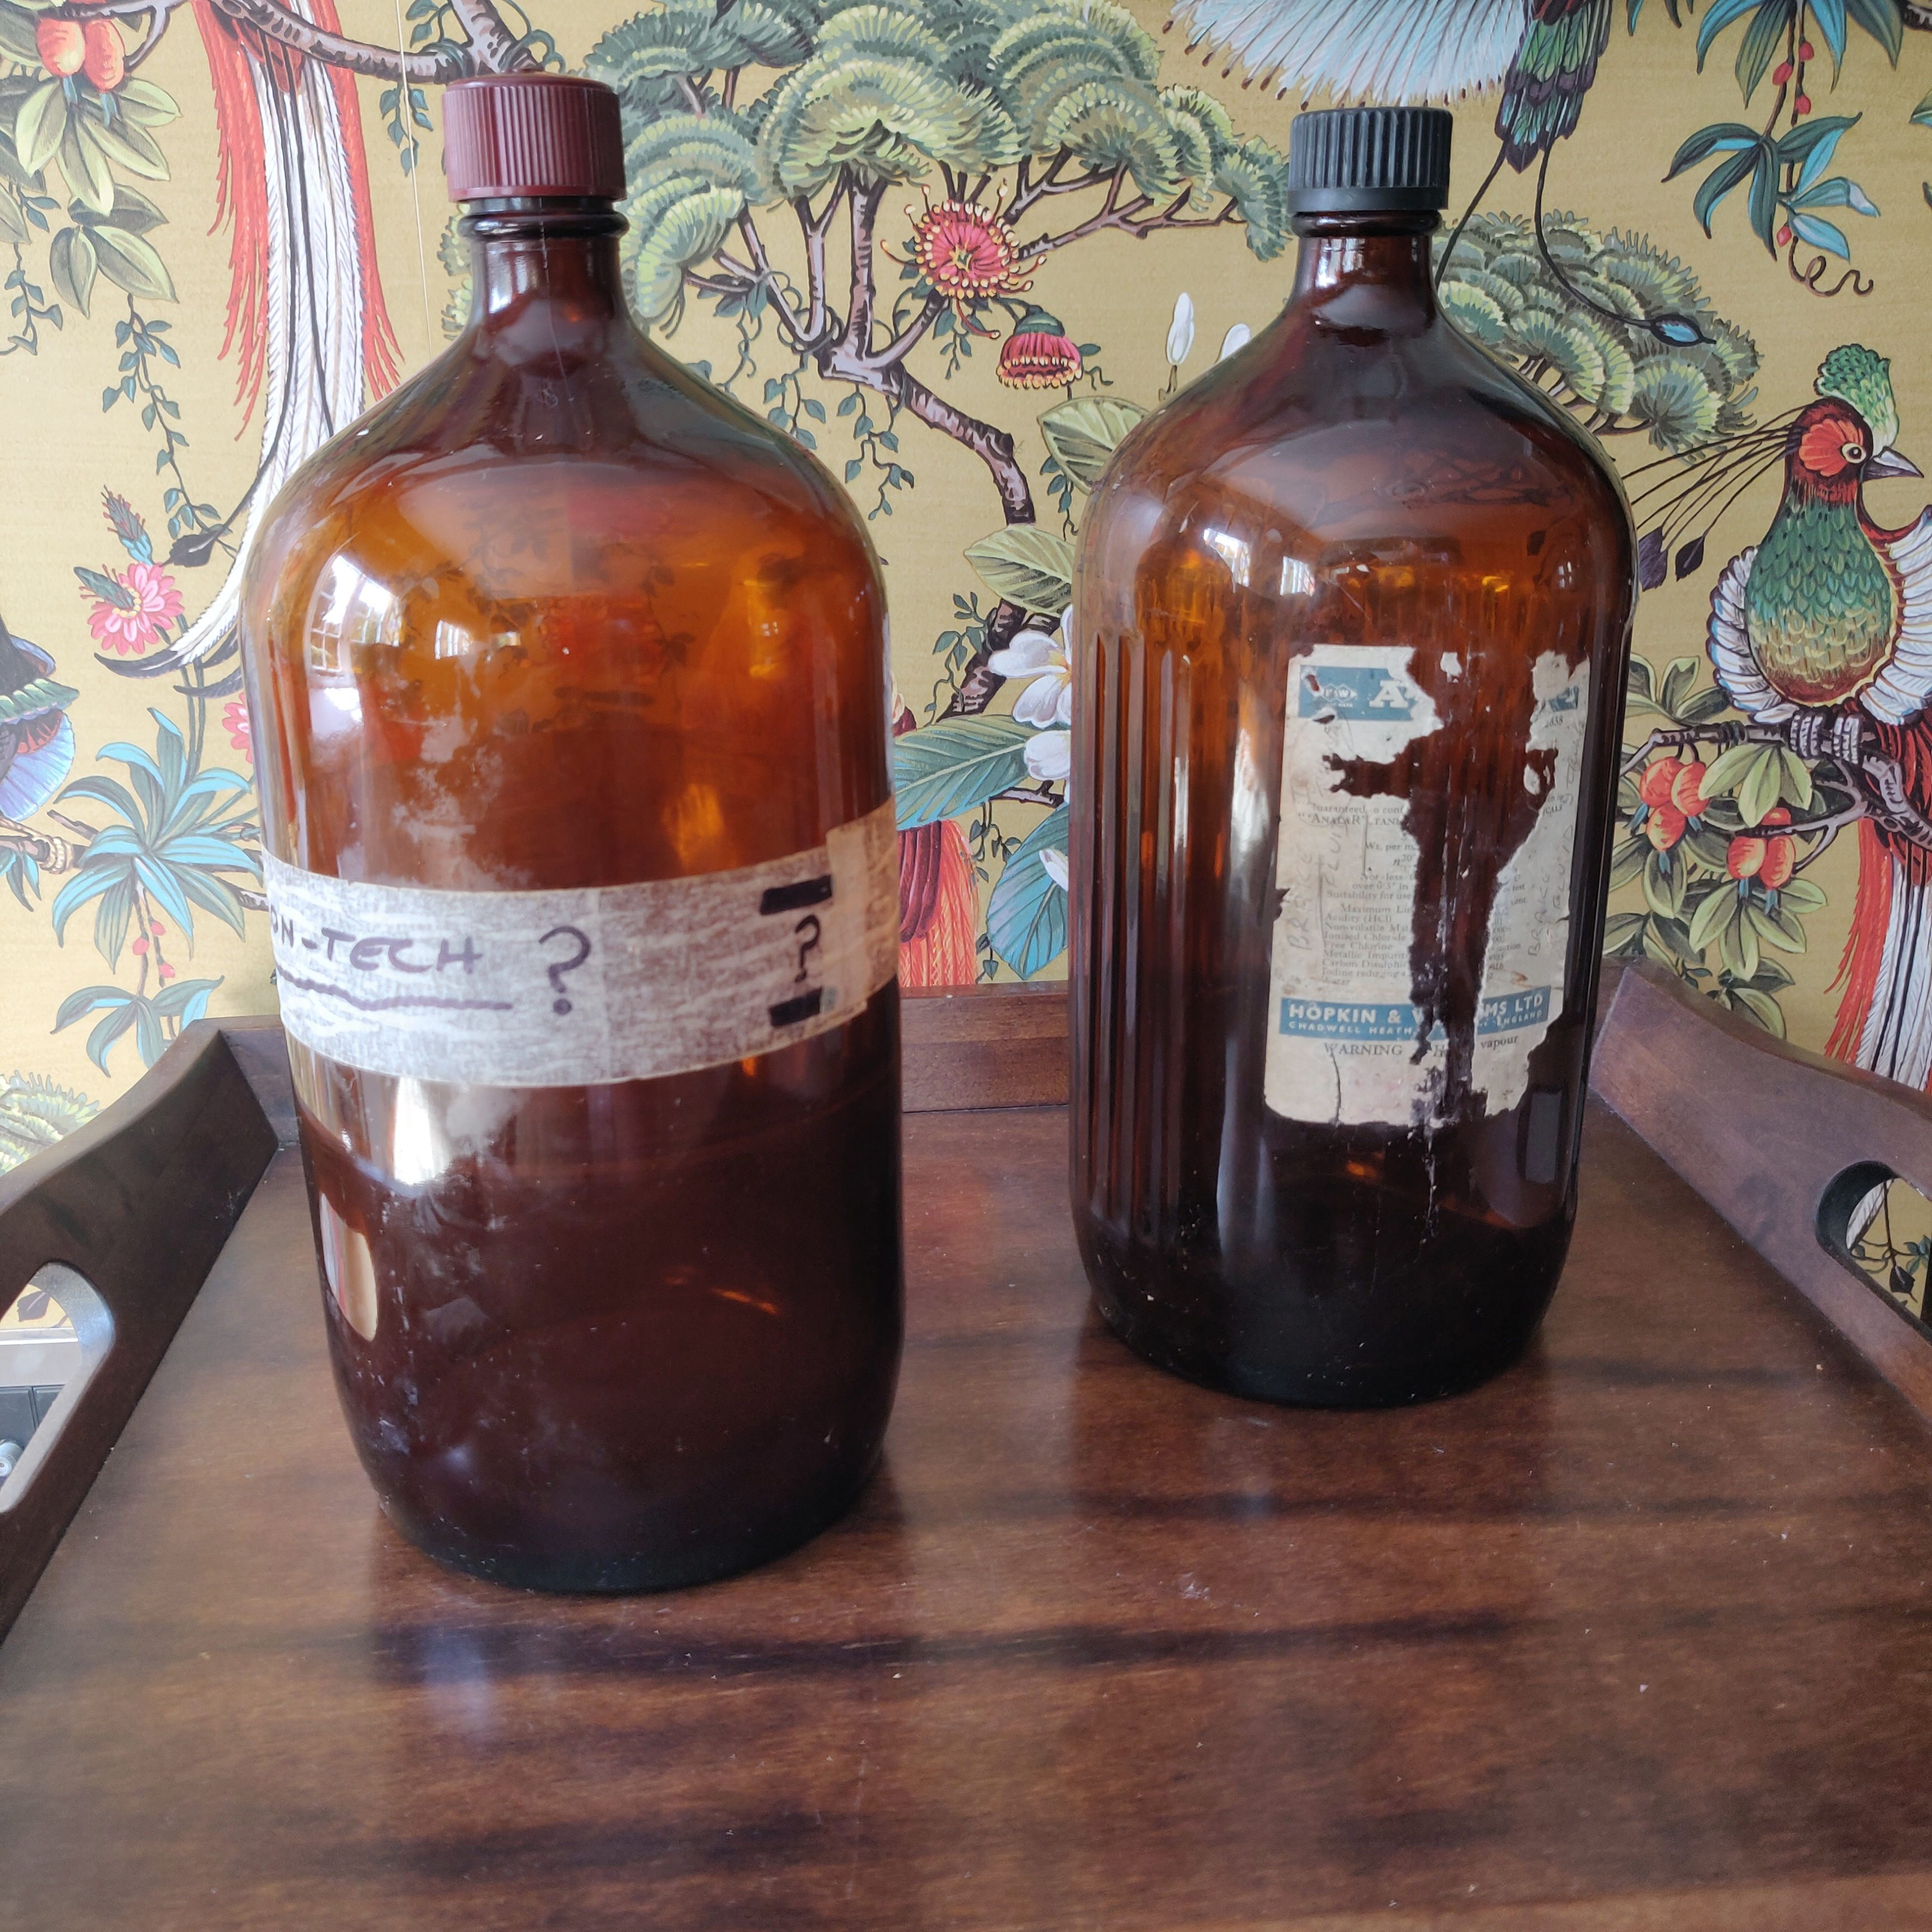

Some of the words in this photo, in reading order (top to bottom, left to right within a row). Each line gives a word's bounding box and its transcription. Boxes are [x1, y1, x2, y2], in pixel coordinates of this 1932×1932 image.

[1515, 993, 1543, 1013] LTD
[1289, 1003, 1377, 1024] HOPKIN
[1288, 1021, 1361, 1034] CHADWELL
[1324, 1041, 1403, 1056] WARNING
[1480, 1035, 1519, 1050] vapour
